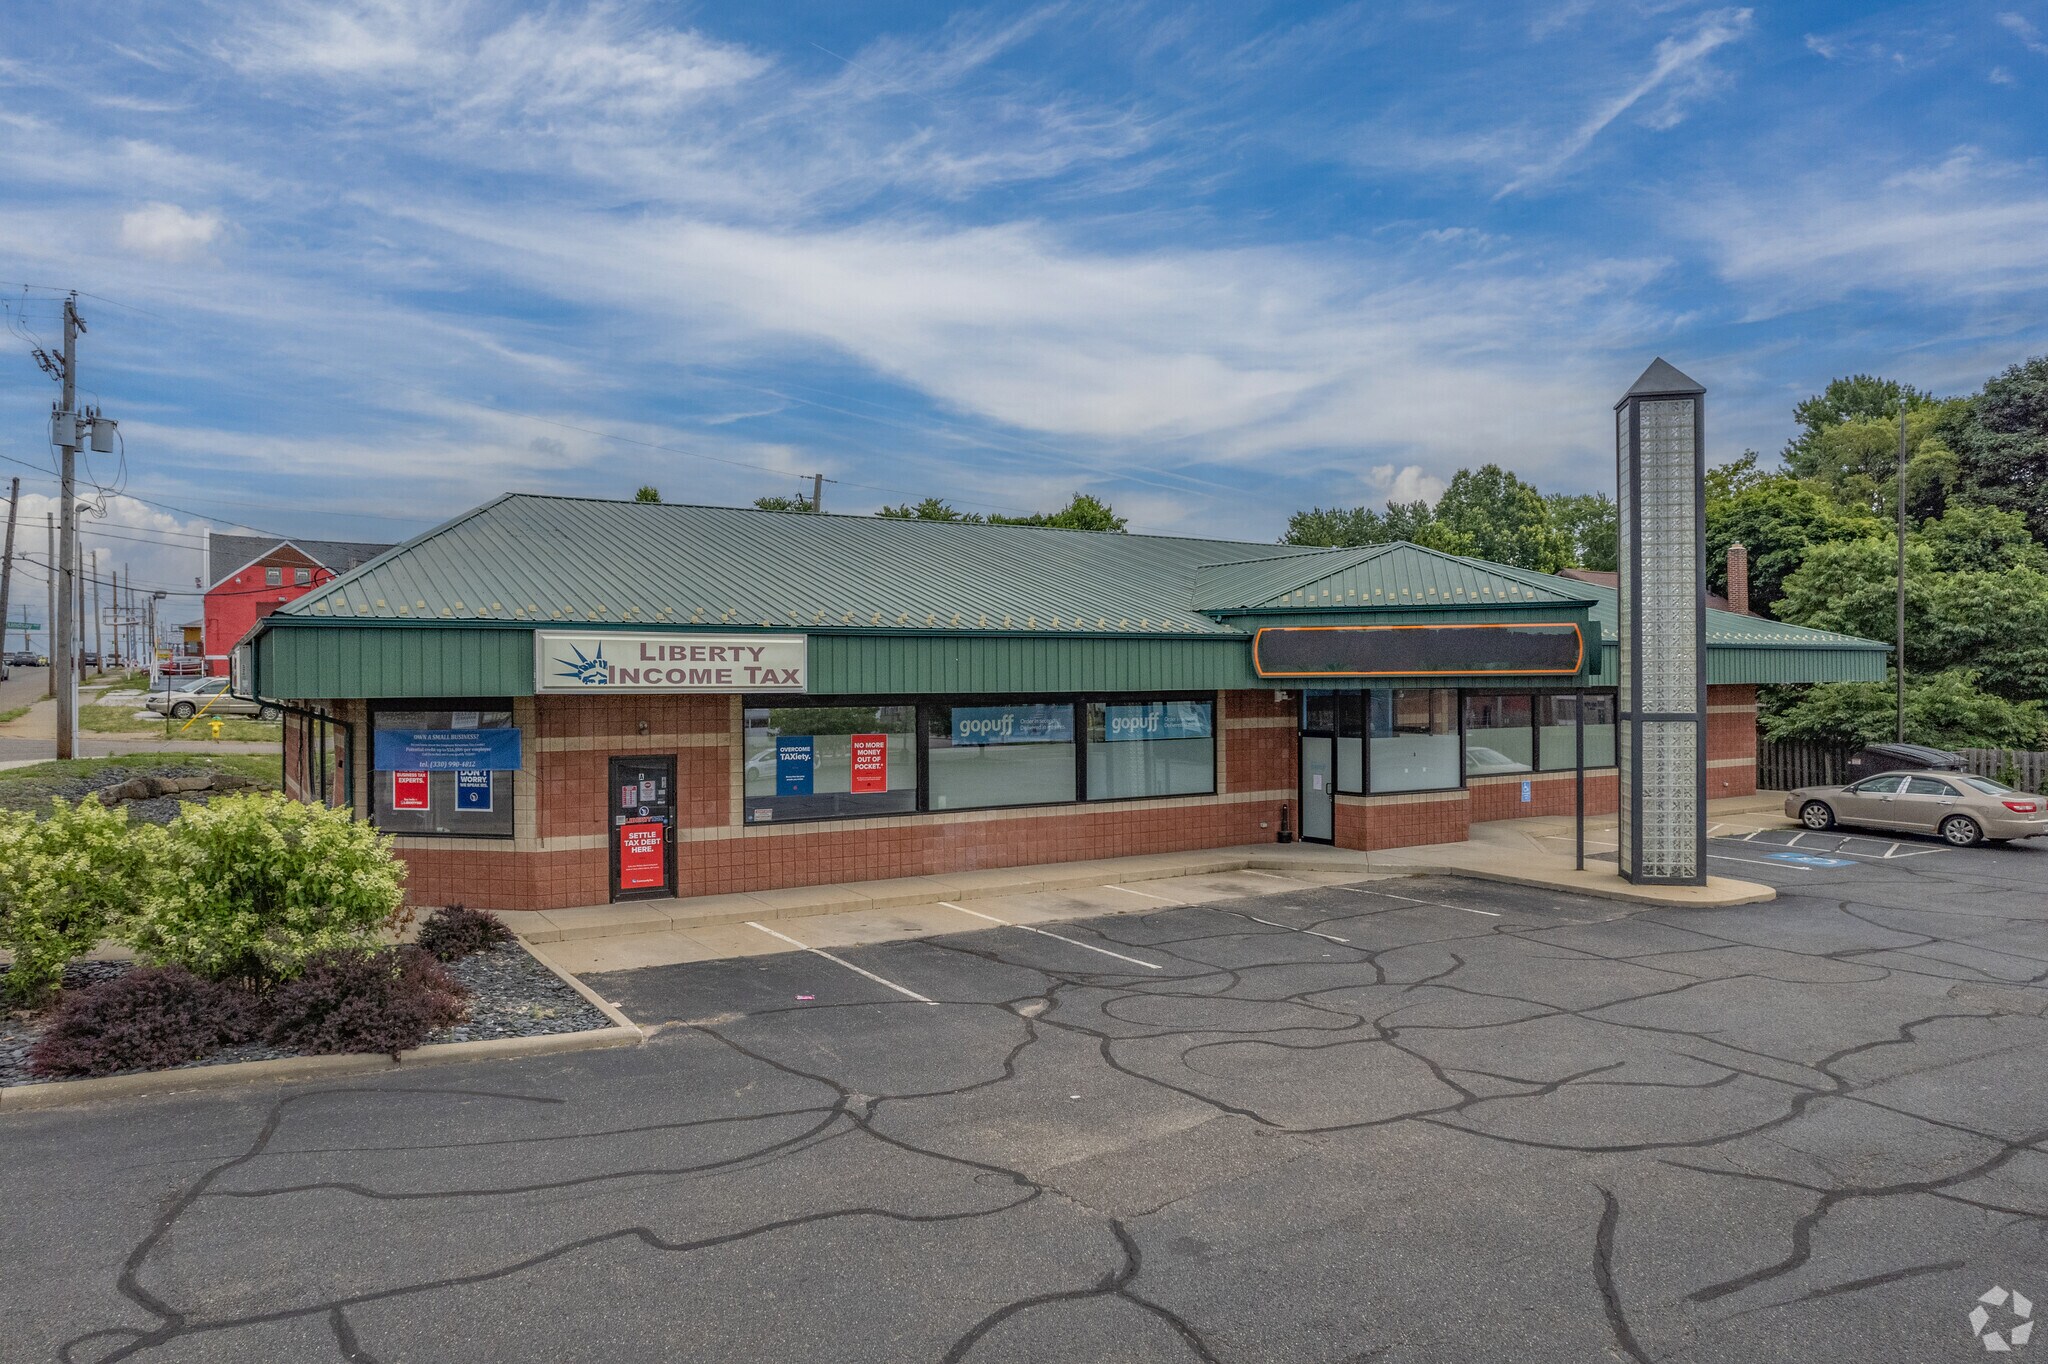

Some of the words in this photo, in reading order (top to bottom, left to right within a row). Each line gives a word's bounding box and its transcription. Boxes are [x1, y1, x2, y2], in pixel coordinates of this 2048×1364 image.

[639, 642, 766, 662] LIBERTY
[608, 665, 732, 685] INCOME
[743, 666, 800, 685] TAX
[960, 714, 1014, 737] gopuff
[1112, 712, 1159, 733] gopuff
[780, 753, 811, 761] TAXiety.
[430, 760, 447, 769] (330)
[628, 831, 656, 839] SETTLE
[640, 838, 661, 846] DEBT
[631, 845, 654, 853] HERE.
